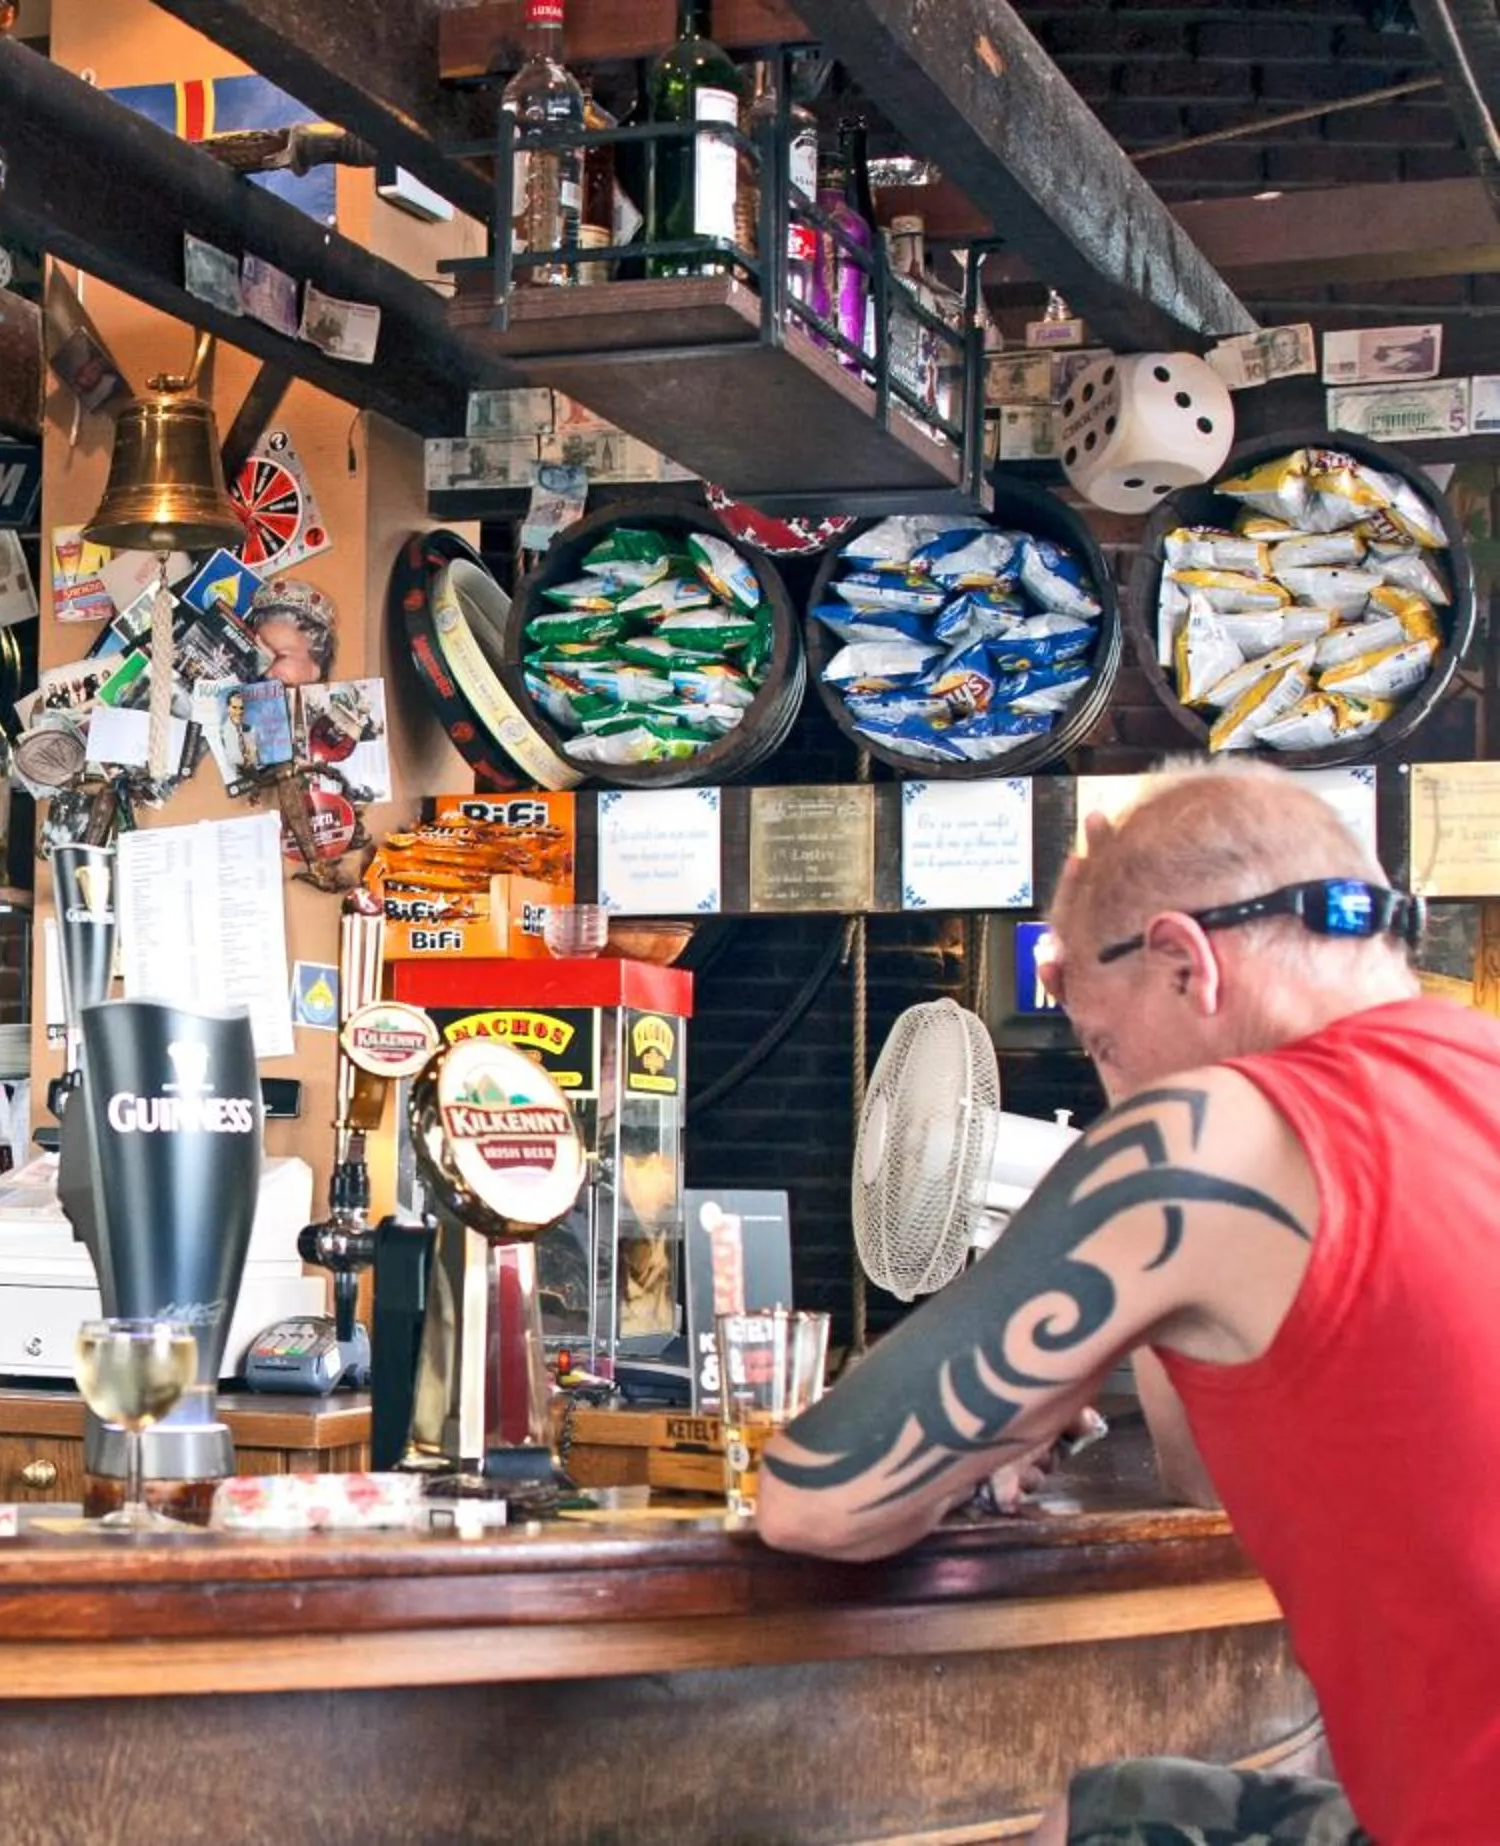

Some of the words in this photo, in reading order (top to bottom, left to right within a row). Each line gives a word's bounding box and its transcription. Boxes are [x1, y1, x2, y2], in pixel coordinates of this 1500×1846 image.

[460, 801, 547, 828] BiFi
[411, 931, 461, 950] BiFi
[453, 1018, 565, 1046] NACHOS
[447, 1107, 568, 1137] KILKENNY
[522, 1147, 555, 1159] BEER
